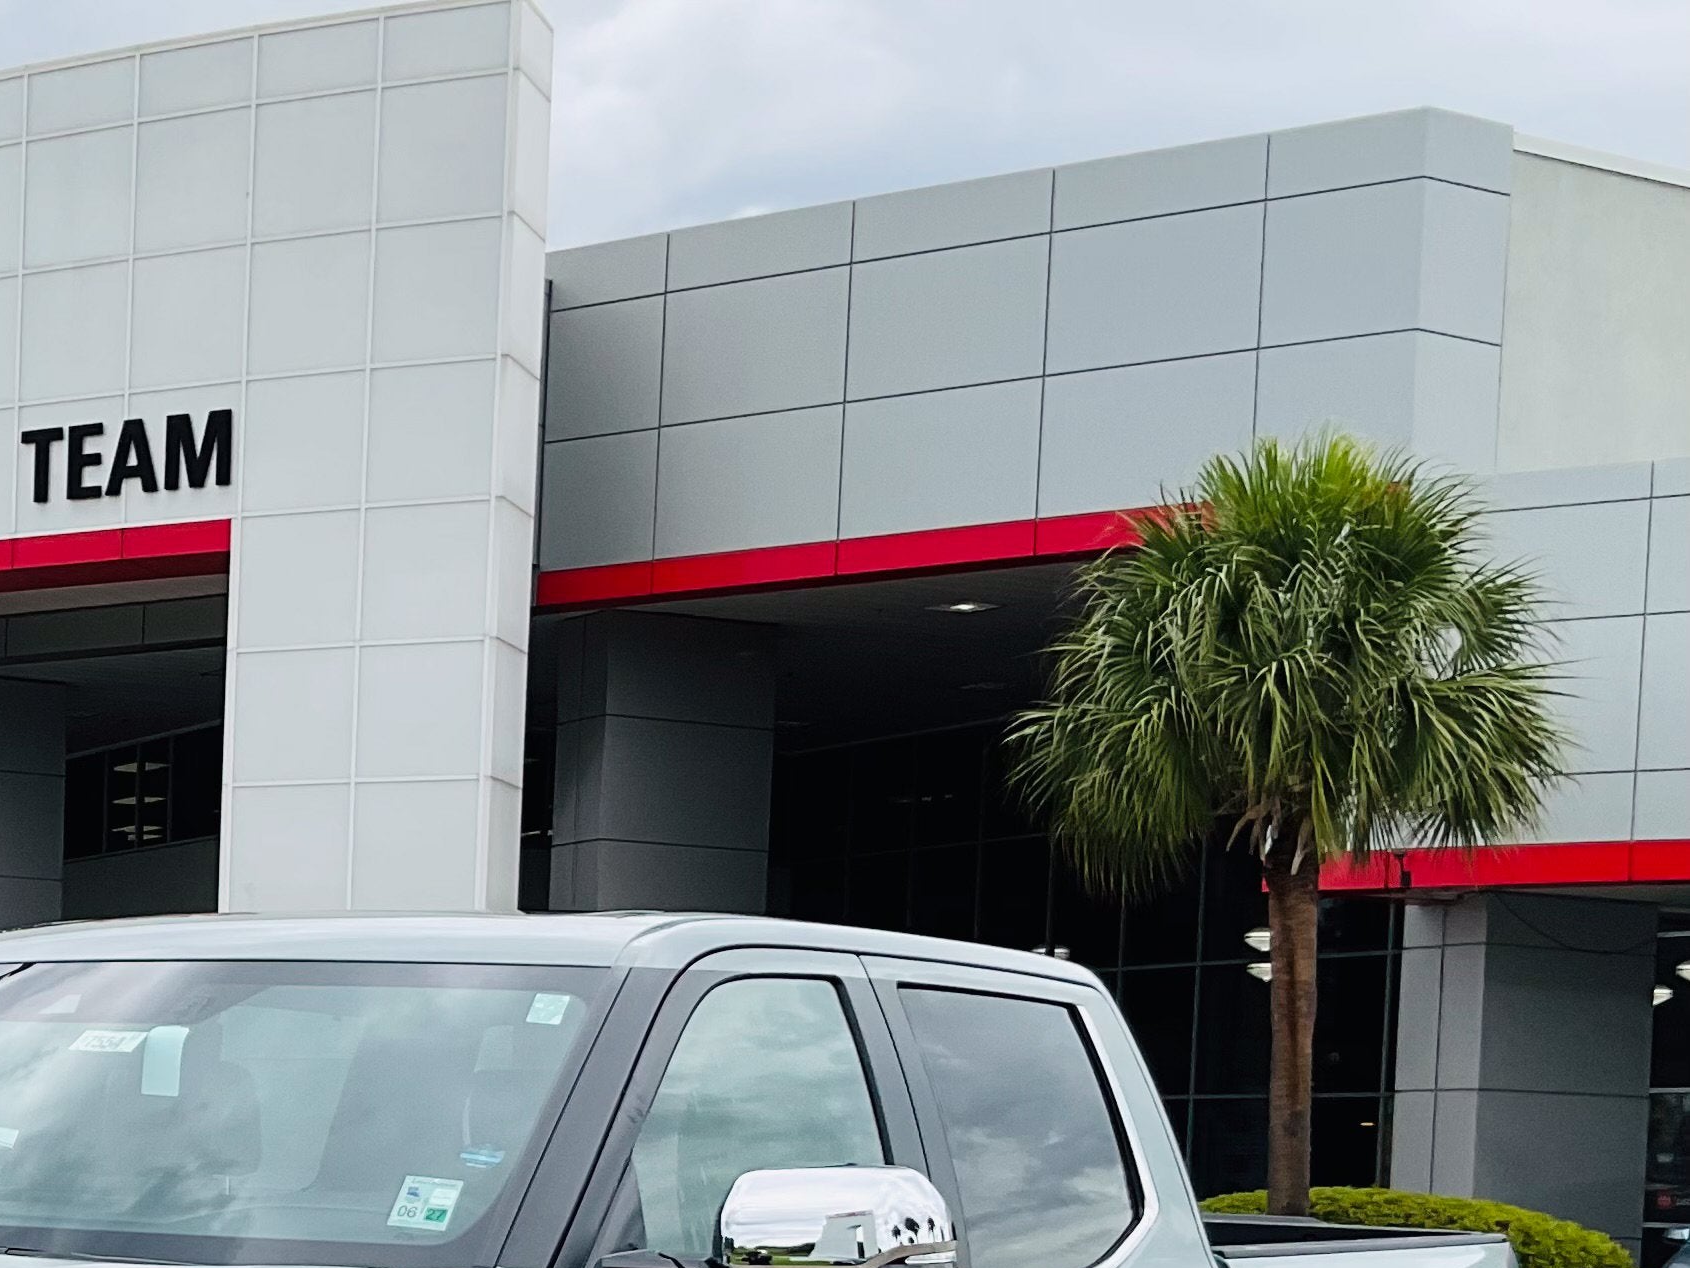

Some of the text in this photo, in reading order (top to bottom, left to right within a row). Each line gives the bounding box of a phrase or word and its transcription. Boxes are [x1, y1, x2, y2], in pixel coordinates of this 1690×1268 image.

[21, 409, 232, 503] TEAM
[397, 1205, 447, 1221] 06 27
